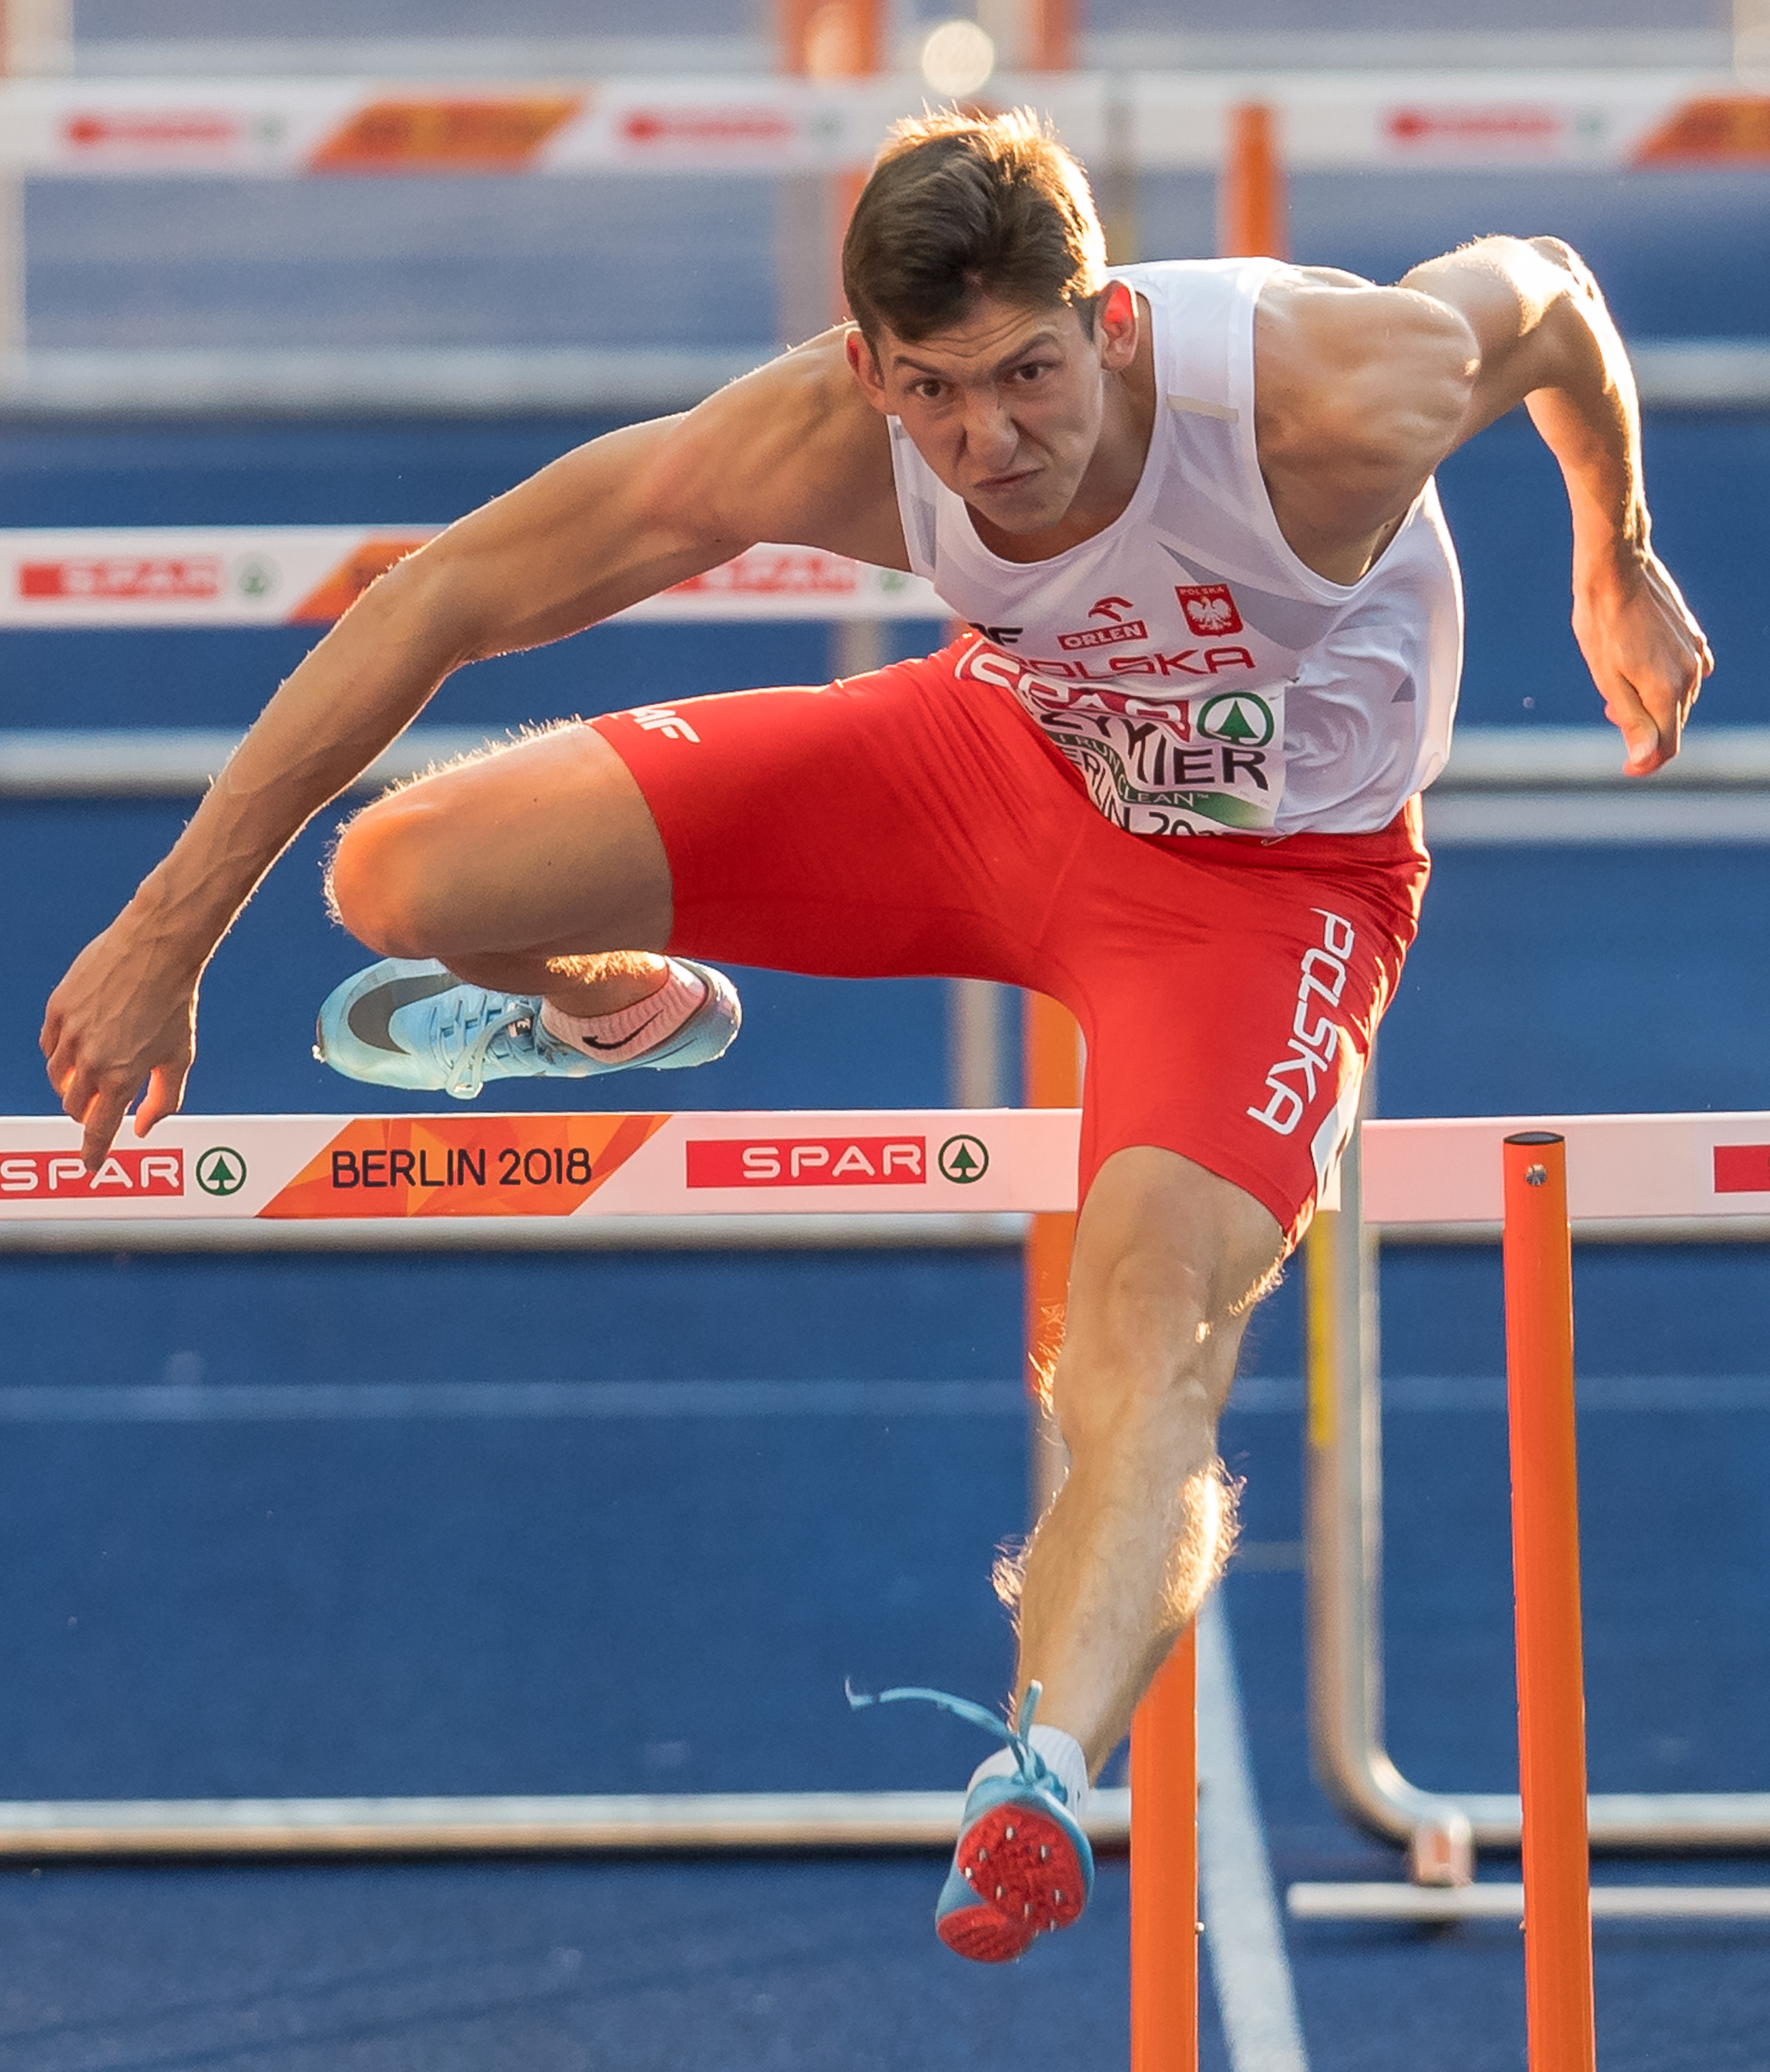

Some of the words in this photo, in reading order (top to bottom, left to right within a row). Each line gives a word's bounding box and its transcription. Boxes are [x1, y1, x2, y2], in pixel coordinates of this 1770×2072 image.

[1064, 624, 1143, 647] ORLEN
[1019, 647, 1256, 679] OLSKA
[0, 1155, 179, 1191] SPAR
[332, 1148, 486, 1188] BERLIN
[498, 1148, 592, 1186] 2018
[742, 1144, 922, 1179] SPAR
